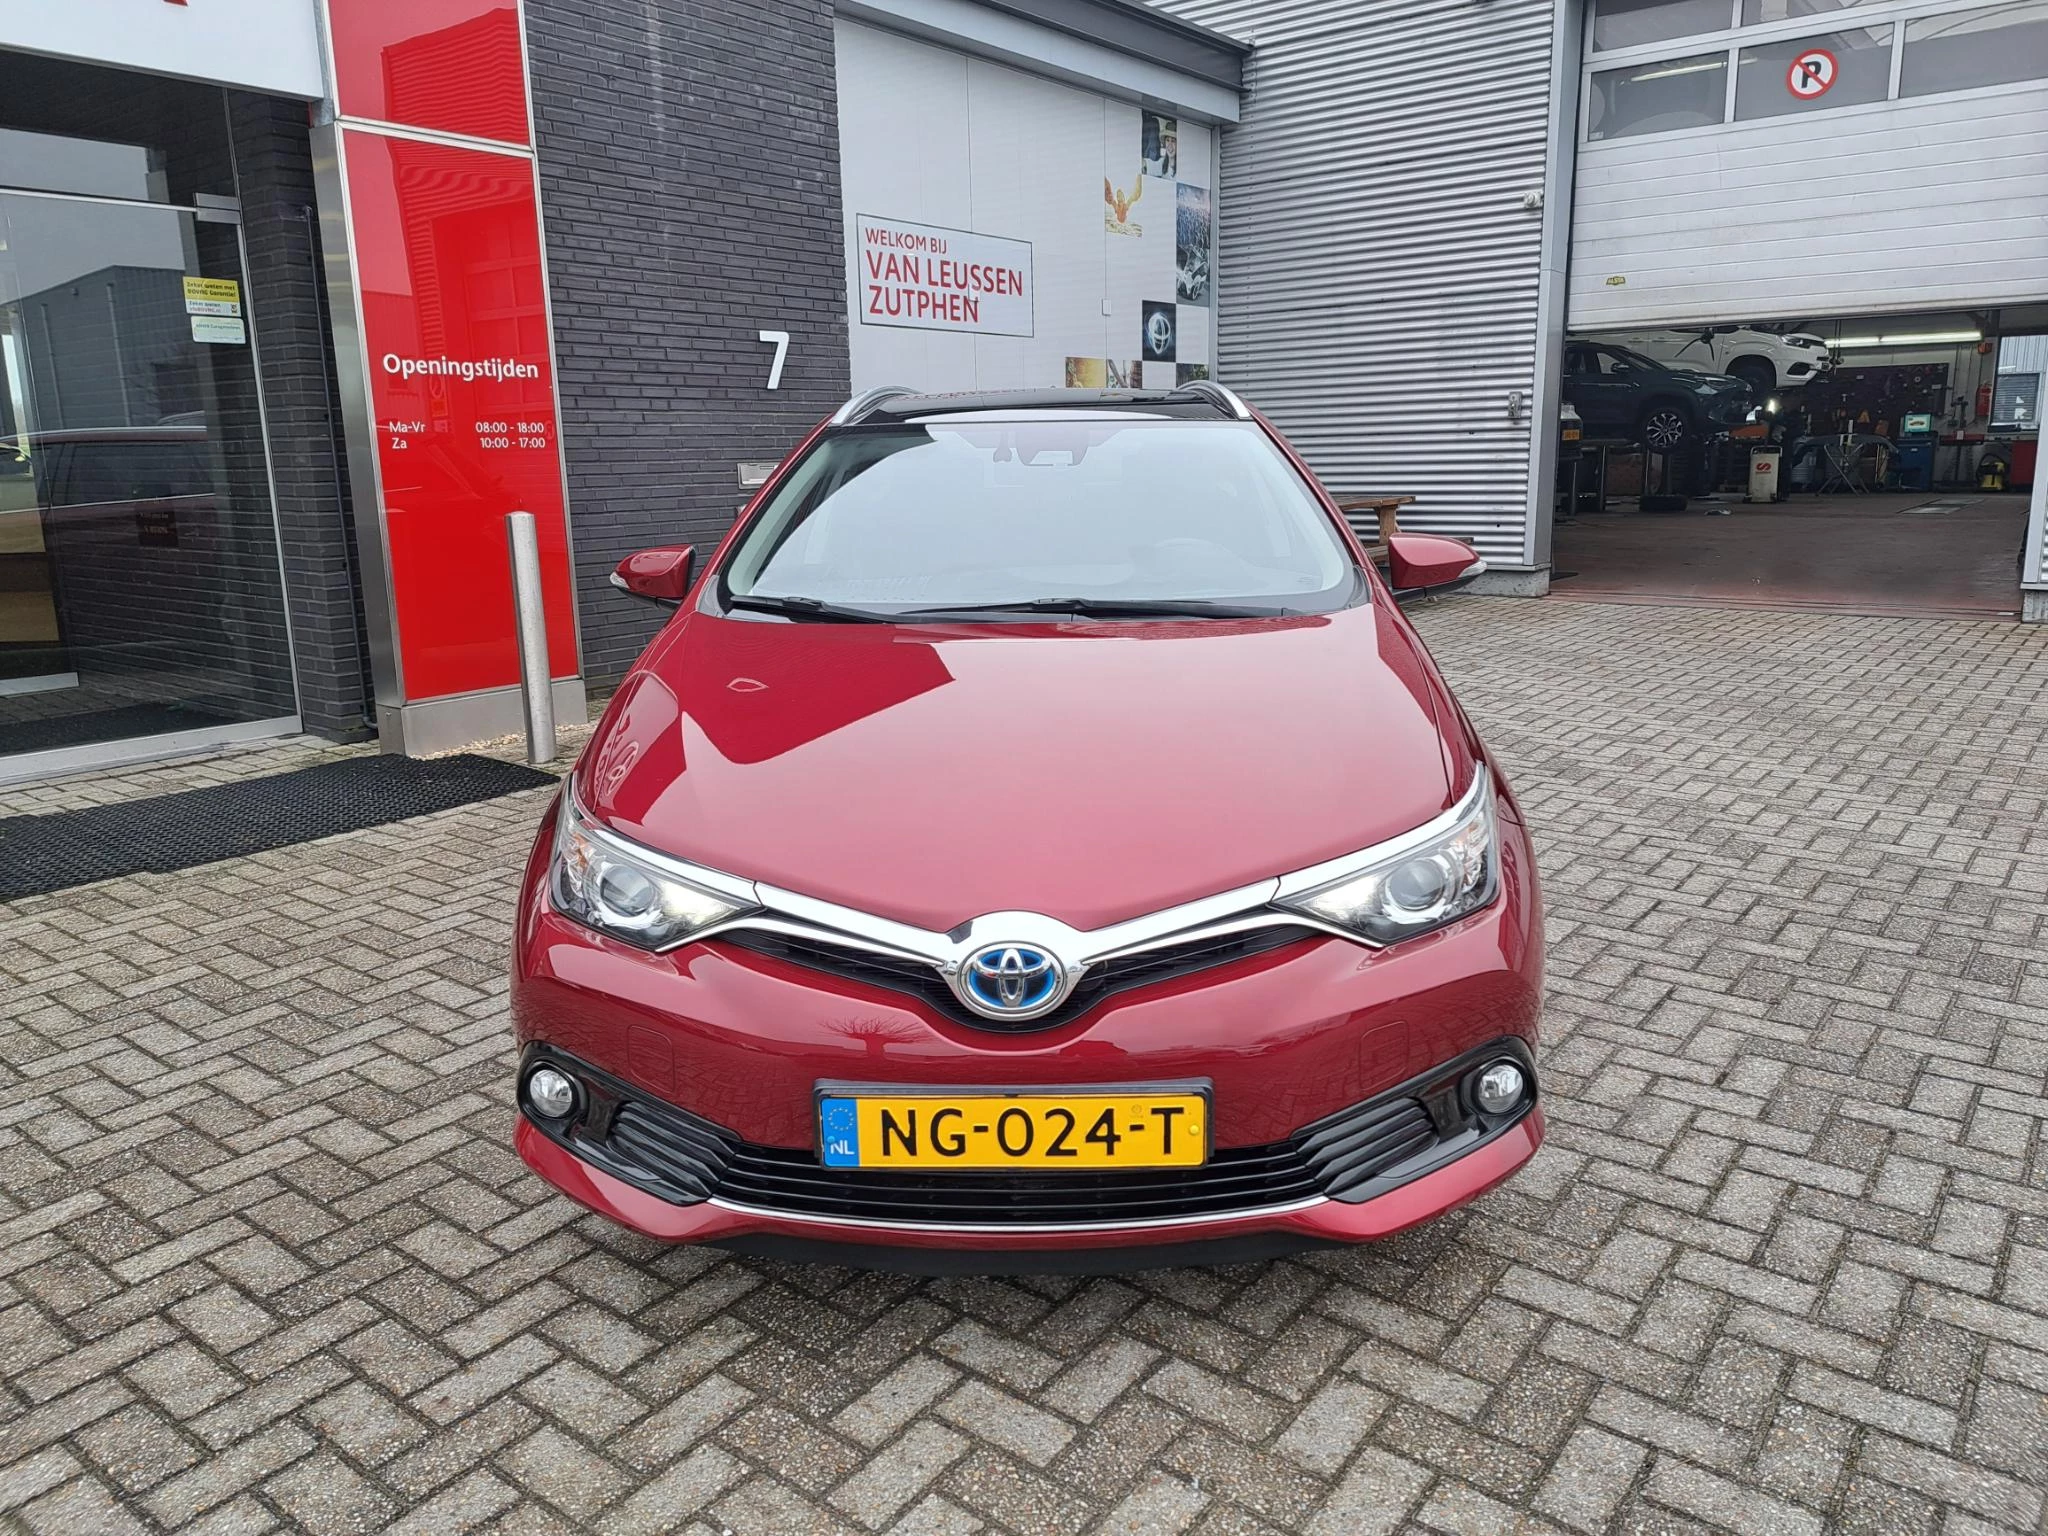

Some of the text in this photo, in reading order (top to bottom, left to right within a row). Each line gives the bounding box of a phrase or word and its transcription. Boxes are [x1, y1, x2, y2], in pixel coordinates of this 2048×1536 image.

[865, 227, 947, 254] WELKOM BIJ
[866, 249, 1023, 296] VAN LEUSSEN
[868, 284, 979, 323] ZUTPHEN
[382, 353, 539, 382] Openingstijden
[759, 331, 790, 390] 7
[388, 421, 426, 433] Ma-Vr
[475, 422, 507, 434] 08:00
[517, 422, 544, 434] 18:00
[391, 437, 408, 449] Za
[480, 437, 509, 449] 10:00
[519, 438, 546, 449] 17:00
[880, 1106, 1185, 1158] NG-024-T
[830, 1142, 855, 1156] NL
